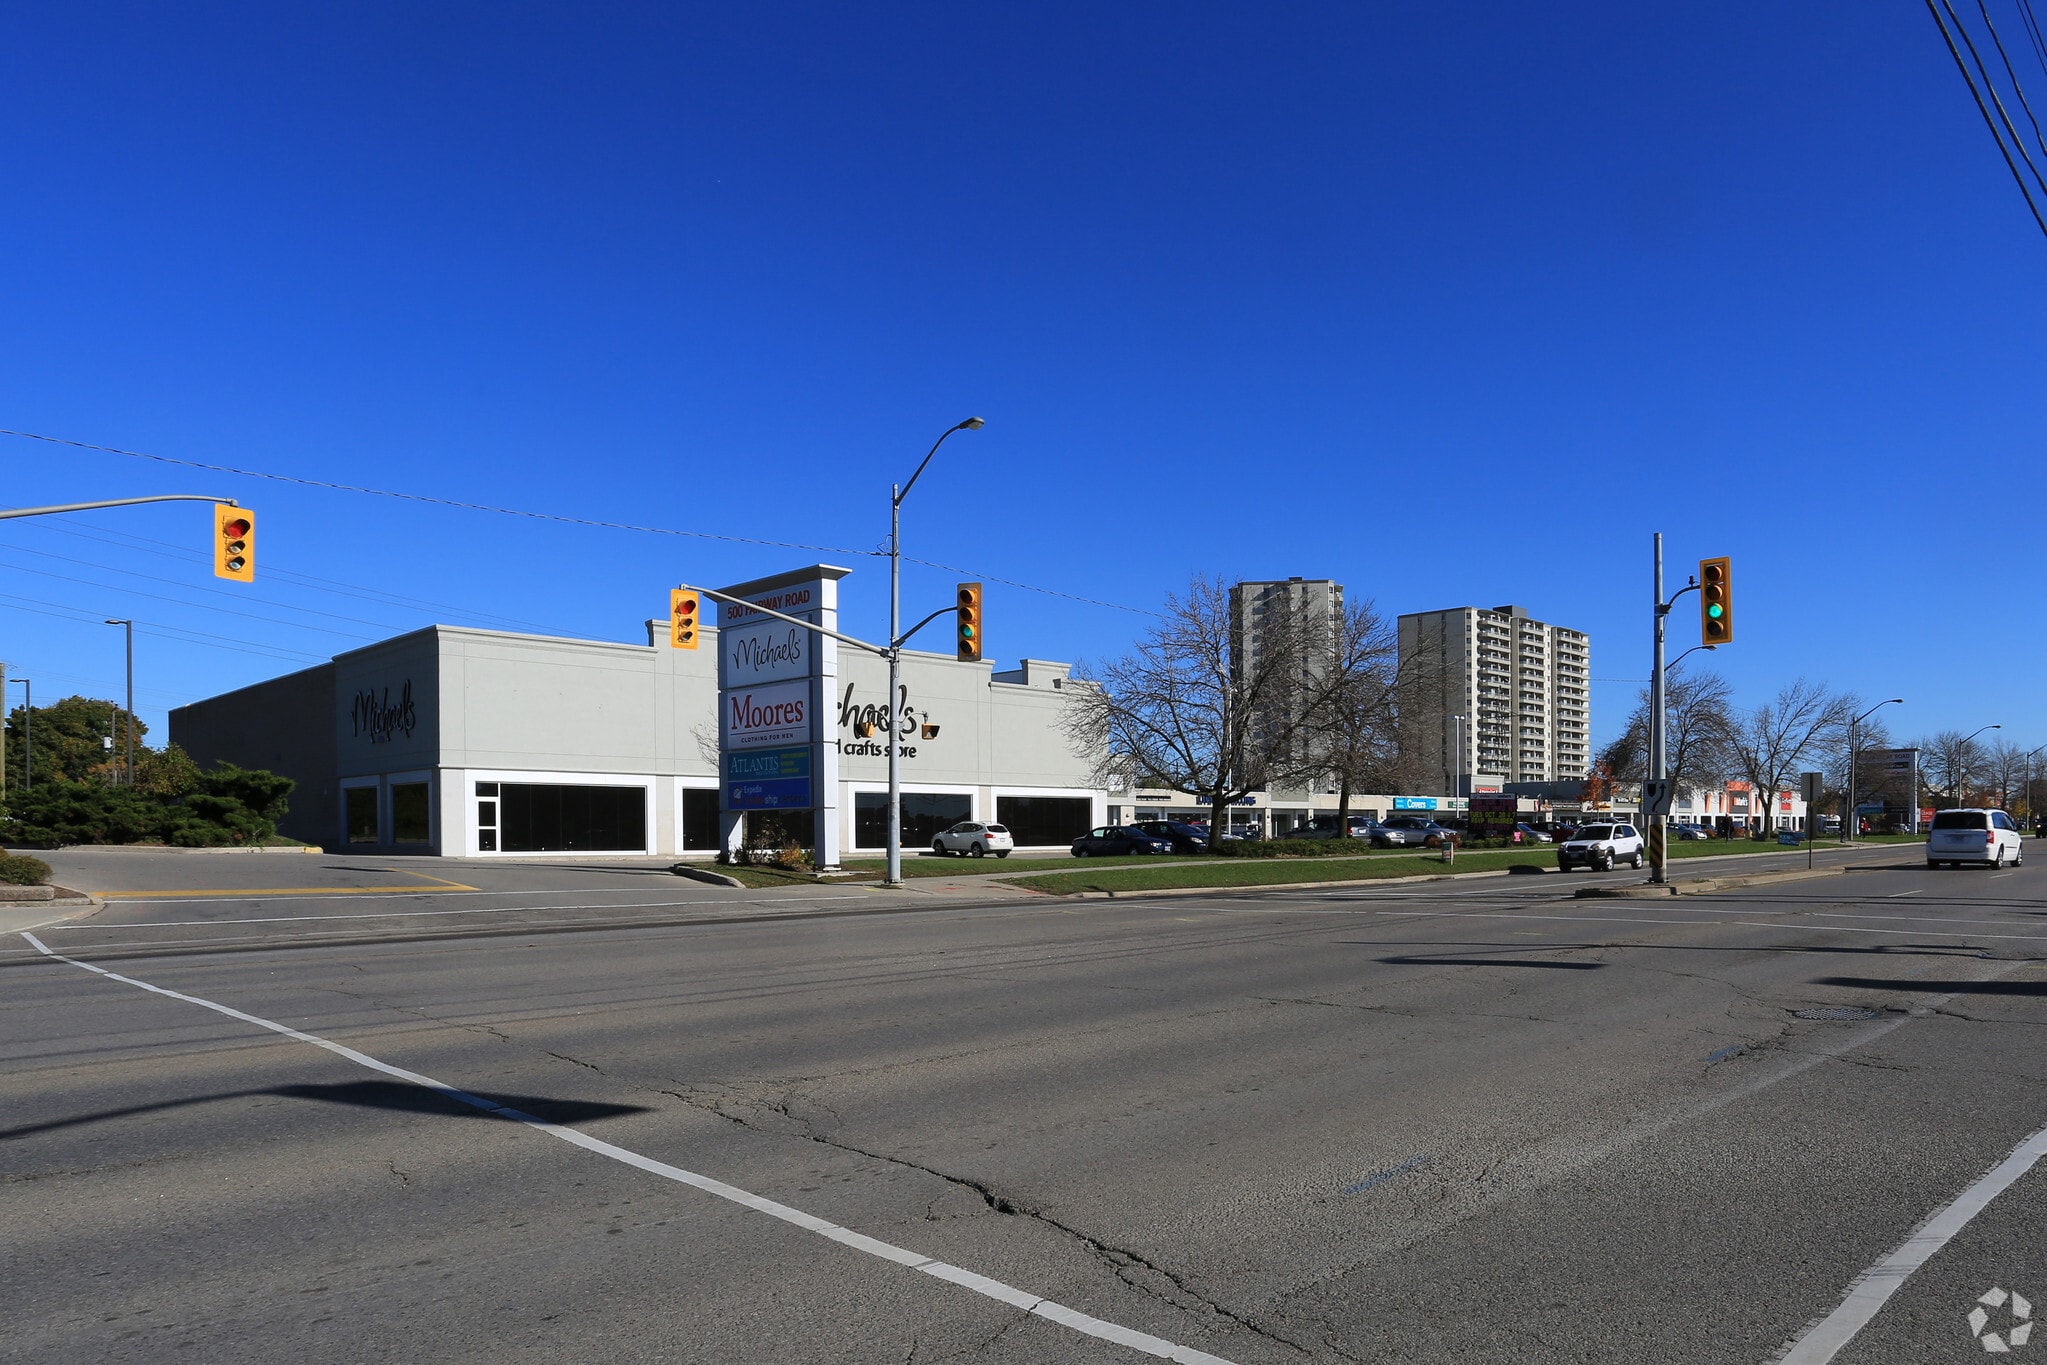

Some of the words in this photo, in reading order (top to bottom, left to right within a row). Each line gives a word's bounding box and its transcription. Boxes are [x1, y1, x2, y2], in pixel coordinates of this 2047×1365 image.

[727, 604, 743, 619] 500
[785, 590, 810, 607] ROAD
[733, 628, 801, 671] Michaels
[351, 679, 416, 744] Michaels
[731, 694, 804, 730] Moores
[844, 740, 882, 756] crafts
[730, 757, 779, 773] ATLANTIS
[1407, 798, 1426, 808] Covers
